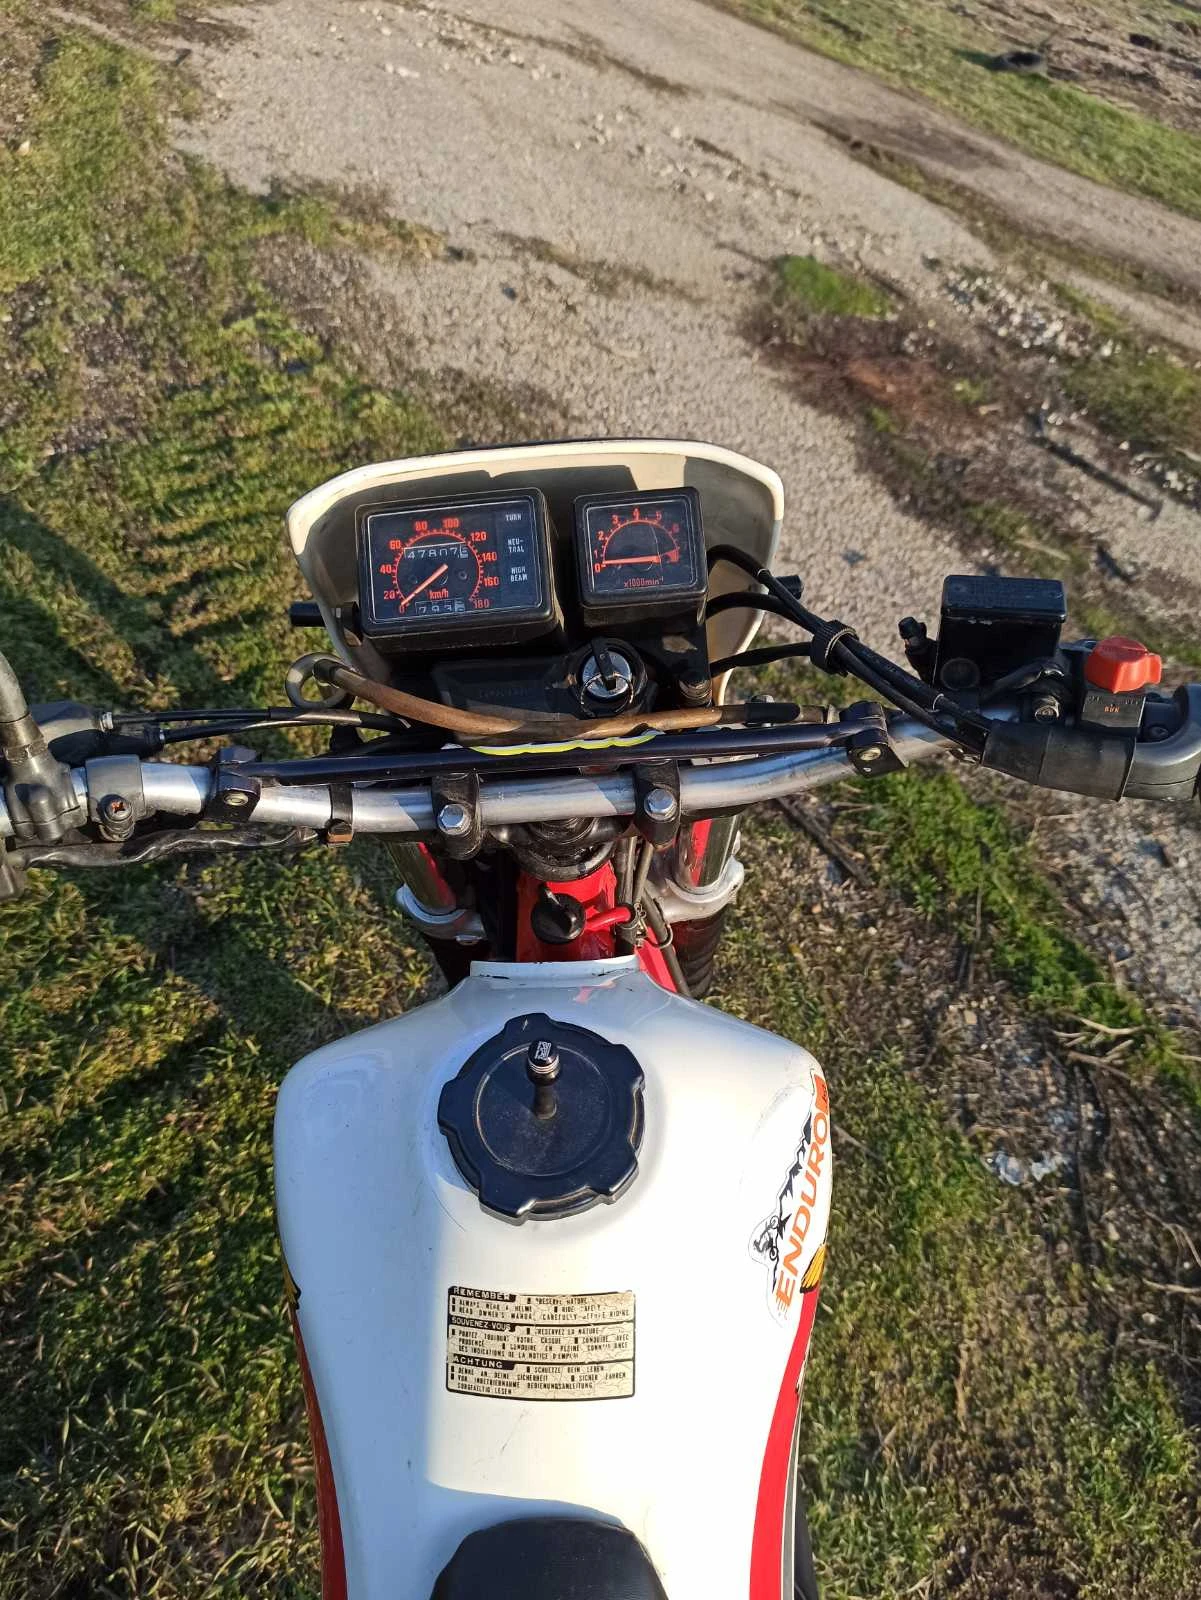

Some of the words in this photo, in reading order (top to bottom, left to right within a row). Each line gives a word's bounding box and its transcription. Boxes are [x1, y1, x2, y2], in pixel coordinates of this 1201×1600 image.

[442, 518, 459, 528] 100
[612, 515, 618, 524] 3
[415, 521, 428, 531] 80
[470, 531, 486, 542] 120
[598, 530, 604, 540] 2
[389, 540, 401, 550] 60
[482, 552, 498, 562] 140
[594, 550, 598, 558] 1
[380, 563, 392, 574] 40
[511, 566, 526, 574] HIGH
[594, 563, 600, 573] 0
[484, 576, 499, 586] 160
[510, 574, 528, 582] BEAM
[384, 590, 396, 600] 20
[428, 590, 448, 600] km/h
[474, 598, 490, 608] 180
[776, 1112, 828, 1308] ENDURO
[454, 1286, 510, 1300] REMEMBER
[452, 1316, 510, 1330] SOUVENEZ-VOUS
[454, 1356, 502, 1368] ACHTUNG
